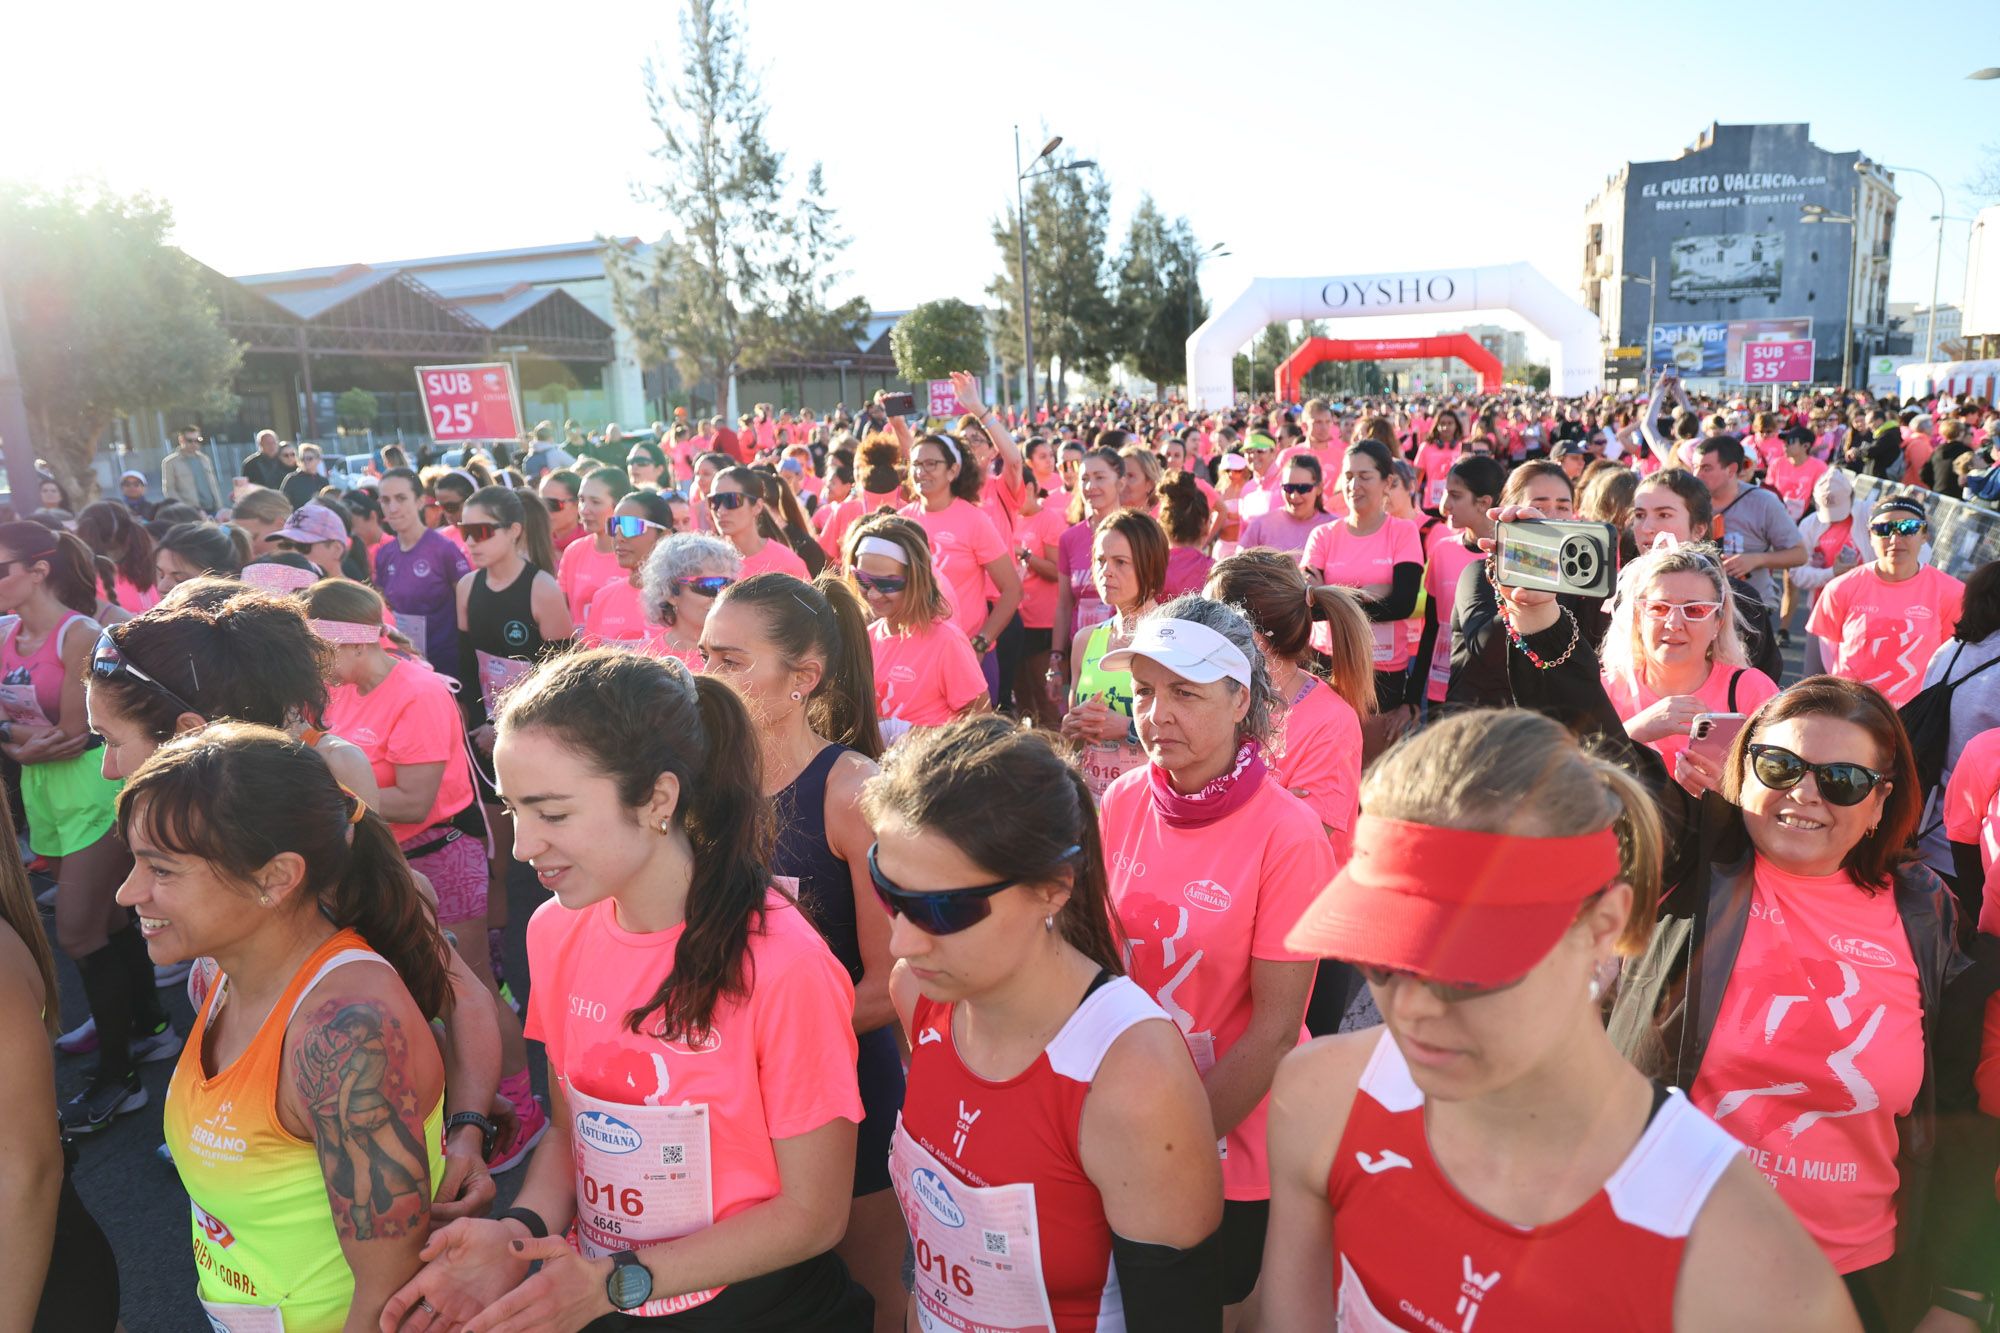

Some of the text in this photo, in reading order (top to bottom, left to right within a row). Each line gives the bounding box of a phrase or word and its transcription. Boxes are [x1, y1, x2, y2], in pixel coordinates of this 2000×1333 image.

[1642, 184, 1658, 198] EL
[1661, 175, 1719, 196] PUERTO
[1322, 275, 1455, 308] OYSHO
[1653, 326, 1727, 345] Del Mar
[1752, 346, 1784, 359] SUB
[427, 373, 473, 395] SUB
[1186, 885, 1228, 908] ASTURIANA
[579, 1118, 636, 1148] ASTURIANA
[956, 1120, 971, 1133] CAX
[191, 1124, 247, 1153] SERRANO
[920, 1137, 935, 1153] Club
[935, 1149, 966, 1175] Atletisme
[1774, 1155, 1797, 1177] LA
[1802, 1159, 1857, 1182] MUJER
[584, 1175, 644, 1217] 016
[915, 1175, 960, 1224] ASTURIANA
[593, 1215, 622, 1235] 4645
[594, 1231, 602, 1243] LA
[604, 1236, 631, 1251] MUJER
[917, 1238, 974, 1297] 016
[934, 1289, 949, 1307] 42
[1461, 1282, 1485, 1302] CAX
[1399, 1299, 1425, 1322] Club
